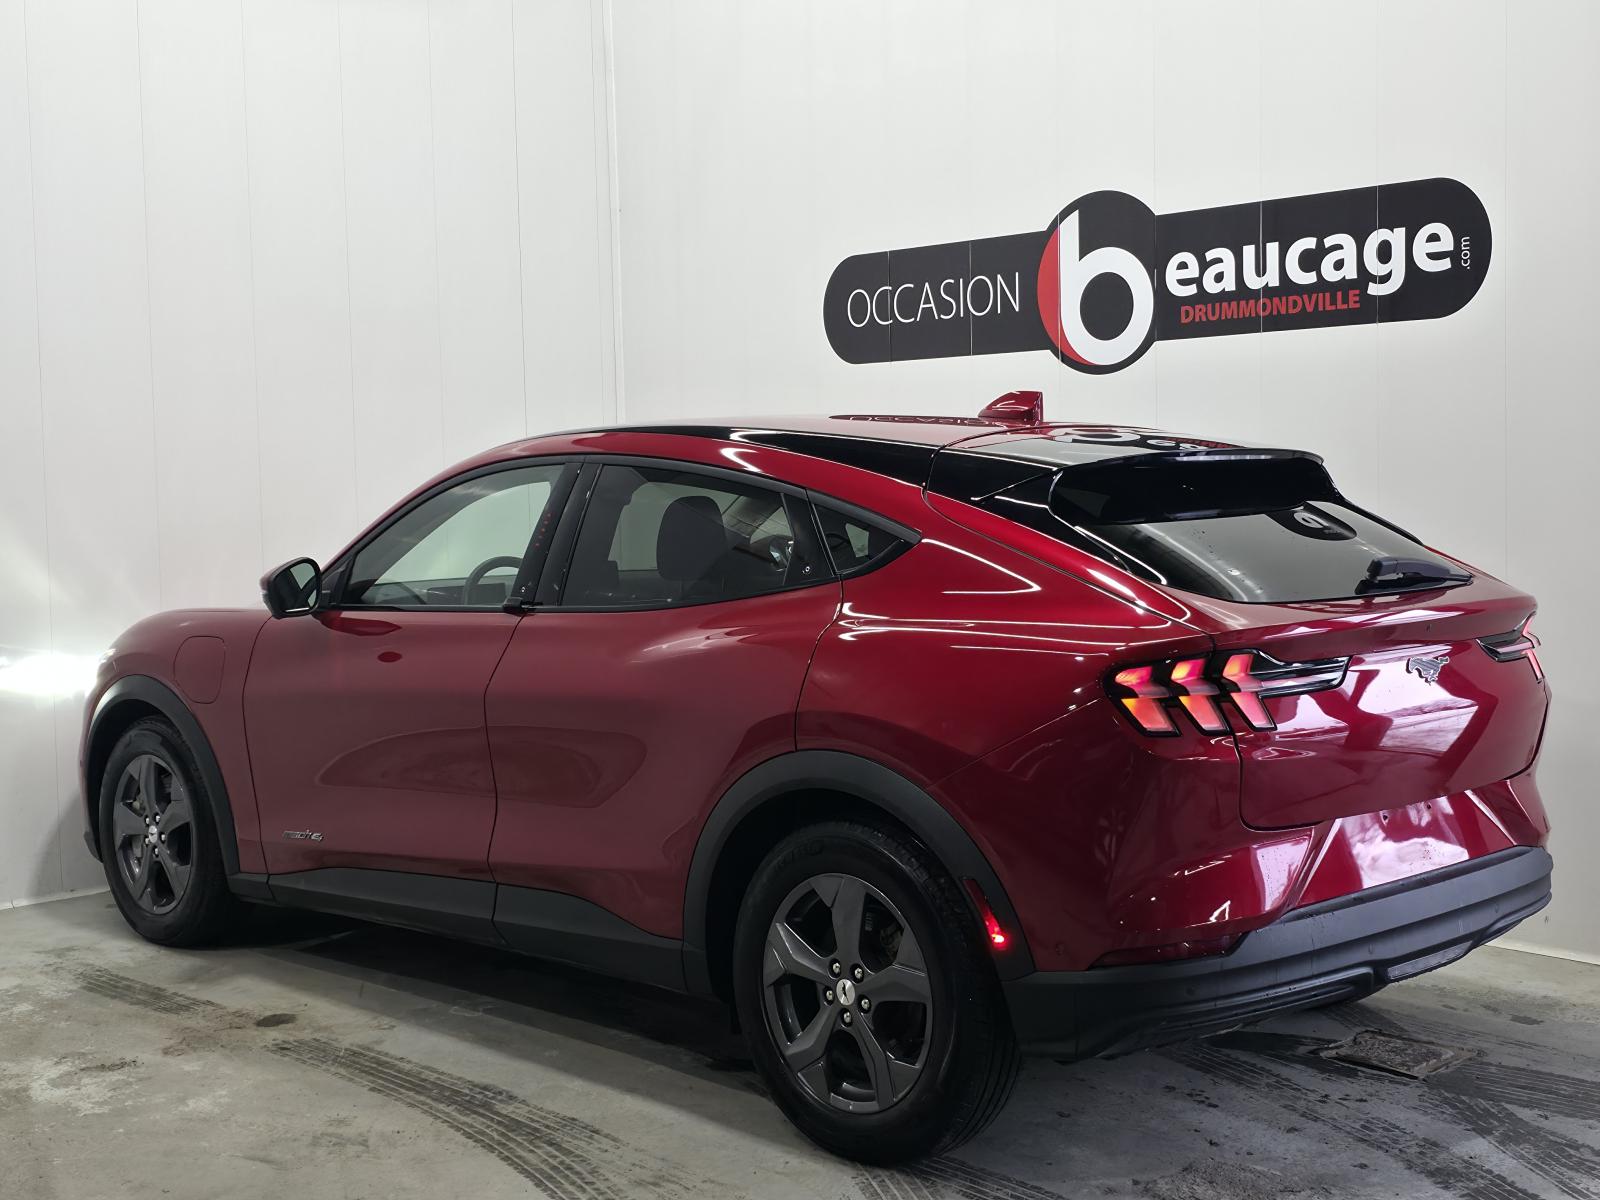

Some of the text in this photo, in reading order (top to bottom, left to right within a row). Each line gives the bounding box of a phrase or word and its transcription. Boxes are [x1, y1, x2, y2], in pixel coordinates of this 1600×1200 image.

[846, 271, 1021, 328] OCCASION
[1460, 236, 1471, 270] .com
[1179, 289, 1361, 325] DRUMMONDVILLE
